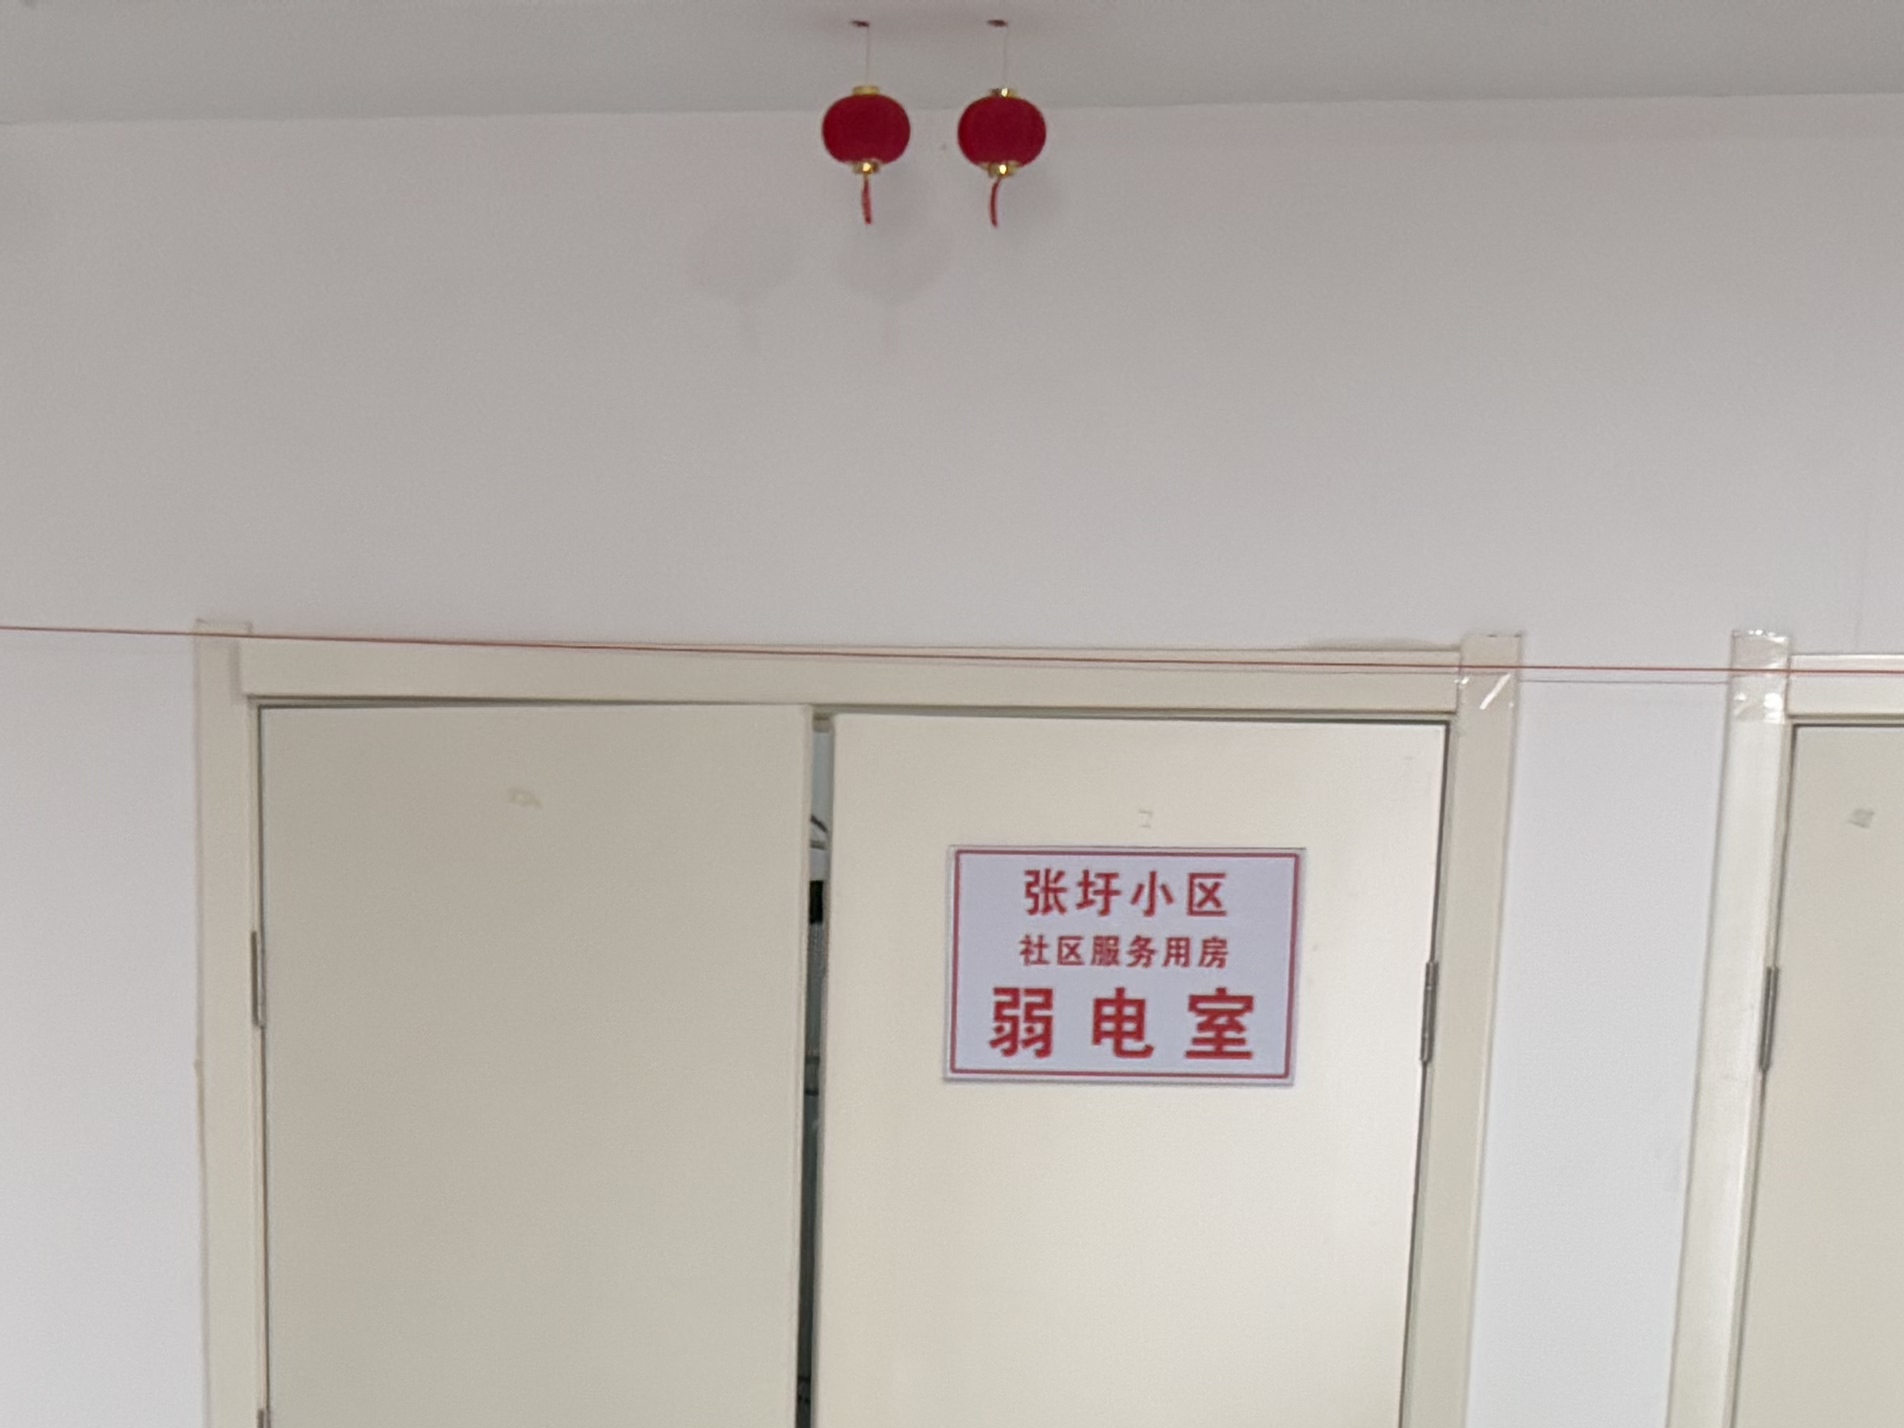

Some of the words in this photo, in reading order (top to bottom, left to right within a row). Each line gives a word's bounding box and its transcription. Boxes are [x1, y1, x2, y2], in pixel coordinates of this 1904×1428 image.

[1024, 867, 1228, 918] 张圩小区
[1018, 934, 1230, 969] 社区服务用房
[990, 986, 1255, 1060] 弱电室
